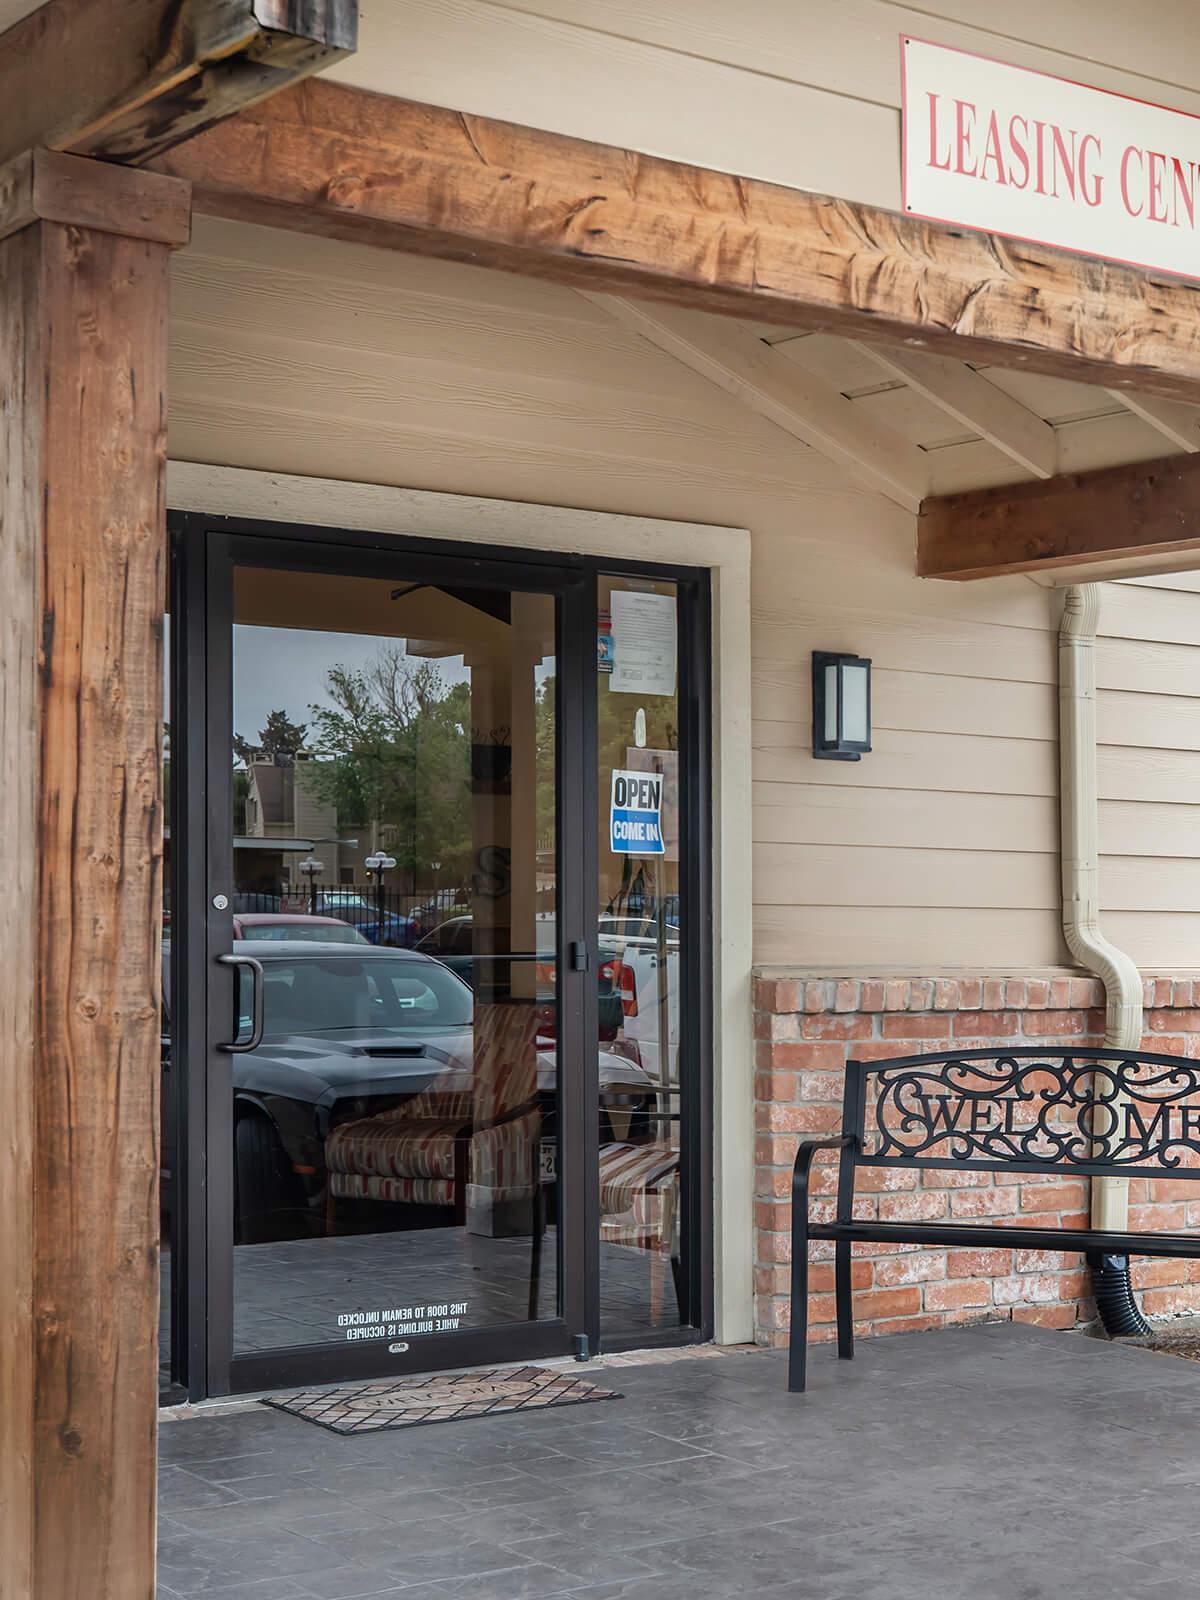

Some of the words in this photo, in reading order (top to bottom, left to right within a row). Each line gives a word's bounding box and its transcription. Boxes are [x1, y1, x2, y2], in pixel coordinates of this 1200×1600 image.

[926, 92, 1104, 207] LEASING
[614, 776, 660, 810] OPEN
[613, 820, 645, 841] COME
[645, 823, 660, 841] IN
